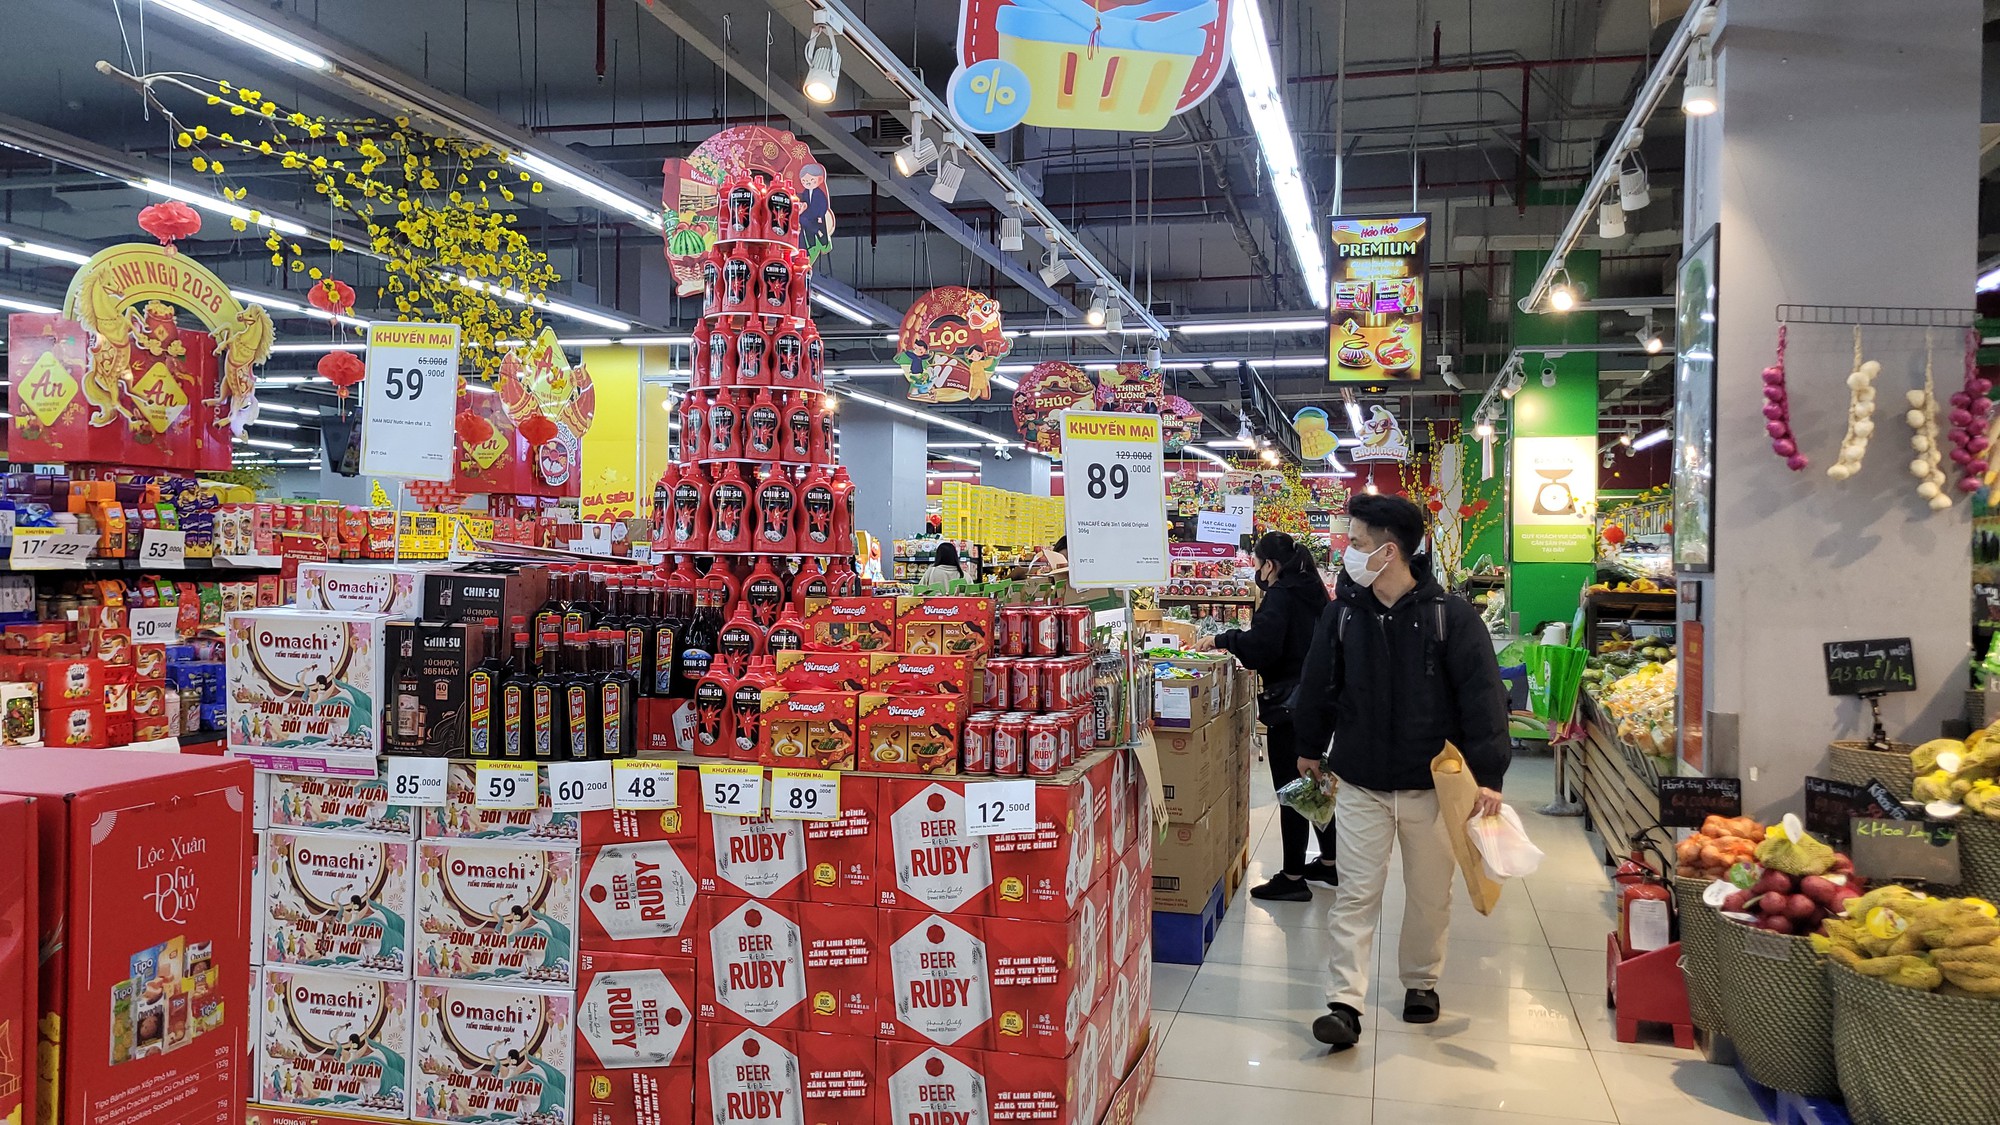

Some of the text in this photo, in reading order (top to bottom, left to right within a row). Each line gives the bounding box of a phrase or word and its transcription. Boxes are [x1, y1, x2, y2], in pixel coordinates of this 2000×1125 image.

[690, 169, 717, 186] WinMart
[1361, 223, 1398, 238] Hảo Hảo
[1340, 242, 1416, 257] PREMIUM
[108, 261, 223, 314] ÍNH NGỌ 2026
[376, 330, 452, 348] KHUYẾN MẠI
[929, 326, 968, 350] LỘC
[418, 357, 447, 365] 65.000đ
[31, 369, 66, 400] An
[386, 368, 445, 400] 59 .900đ
[1035, 394, 1072, 408] PHÚC
[1115, 392, 1145, 400] VƯỢNG
[1070, 421, 1154, 440] KHUYẾN MẠI
[1116, 451, 1152, 460] 129.000đ
[1087, 463, 1151, 500] 89 .000đ
[583, 491, 634, 506] GIÁ SIÊU
[1231, 506, 1244, 515] 73
[50, 544, 78, 555] 122
[149, 543, 167, 557] 53
[464, 587, 500, 598] CHIN-SU
[137, 621, 155, 636] 50
[722, 634, 750, 642] CHIN-SU
[260, 631, 328, 650] Omachi
[474, 682, 487, 694] Nam
[698, 688, 722, 697] CHIN-SU
[301, 781, 388, 801] ĐÓN MÙA XUÂN
[396, 775, 440, 795] 85 .000đ
[489, 778, 516, 798] 59
[559, 780, 607, 801] 60 .200đ
[628, 777, 656, 797] 48
[715, 783, 740, 805] 52
[321, 798, 368, 818] ĐỔI MỚI
[789, 788, 817, 809] 89
[978, 801, 1030, 823] 12 .500đ
[920, 819, 957, 838] BEER
[137, 835, 206, 870] Lộc Xuân
[730, 833, 787, 864] RUBY
[299, 849, 364, 870] Omachi
[452, 860, 525, 879] Omachi
[911, 846, 971, 877] RUBY
[143, 865, 195, 914] Phú
[635, 861, 666, 921] RUBY
[159, 886, 199, 924] Quý
[450, 931, 547, 951] ĐÓN MÙA XUÂN
[738, 934, 773, 952] BEER
[133, 958, 153, 974] Tipo
[471, 946, 524, 968] ĐỔI MỚI
[920, 952, 956, 969] BEER
[114, 987, 133, 1000] Tipo
[295, 986, 363, 1009] Omachi
[910, 978, 971, 1009] RUBY
[881, 1022, 895, 1030] BIA
[292, 1055, 382, 1079] ĐÓN MÙA XUÂN
[736, 1065, 771, 1081] BEER
[312, 1073, 361, 1095] ĐỔI MỚI
[94, 1099, 109, 1109] Tipo
[110, 1091, 126, 1104] Bánh
[127, 1085, 140, 1096] Kem
[94, 1114, 109, 1125] Tipo
[110, 1106, 126, 1118] Bánh
[127, 1095, 150, 1110] Cracker
[151, 1090, 163, 1098] Rau
[127, 1110, 152, 1124] Cookies
[152, 1099, 173, 1112] Socola
